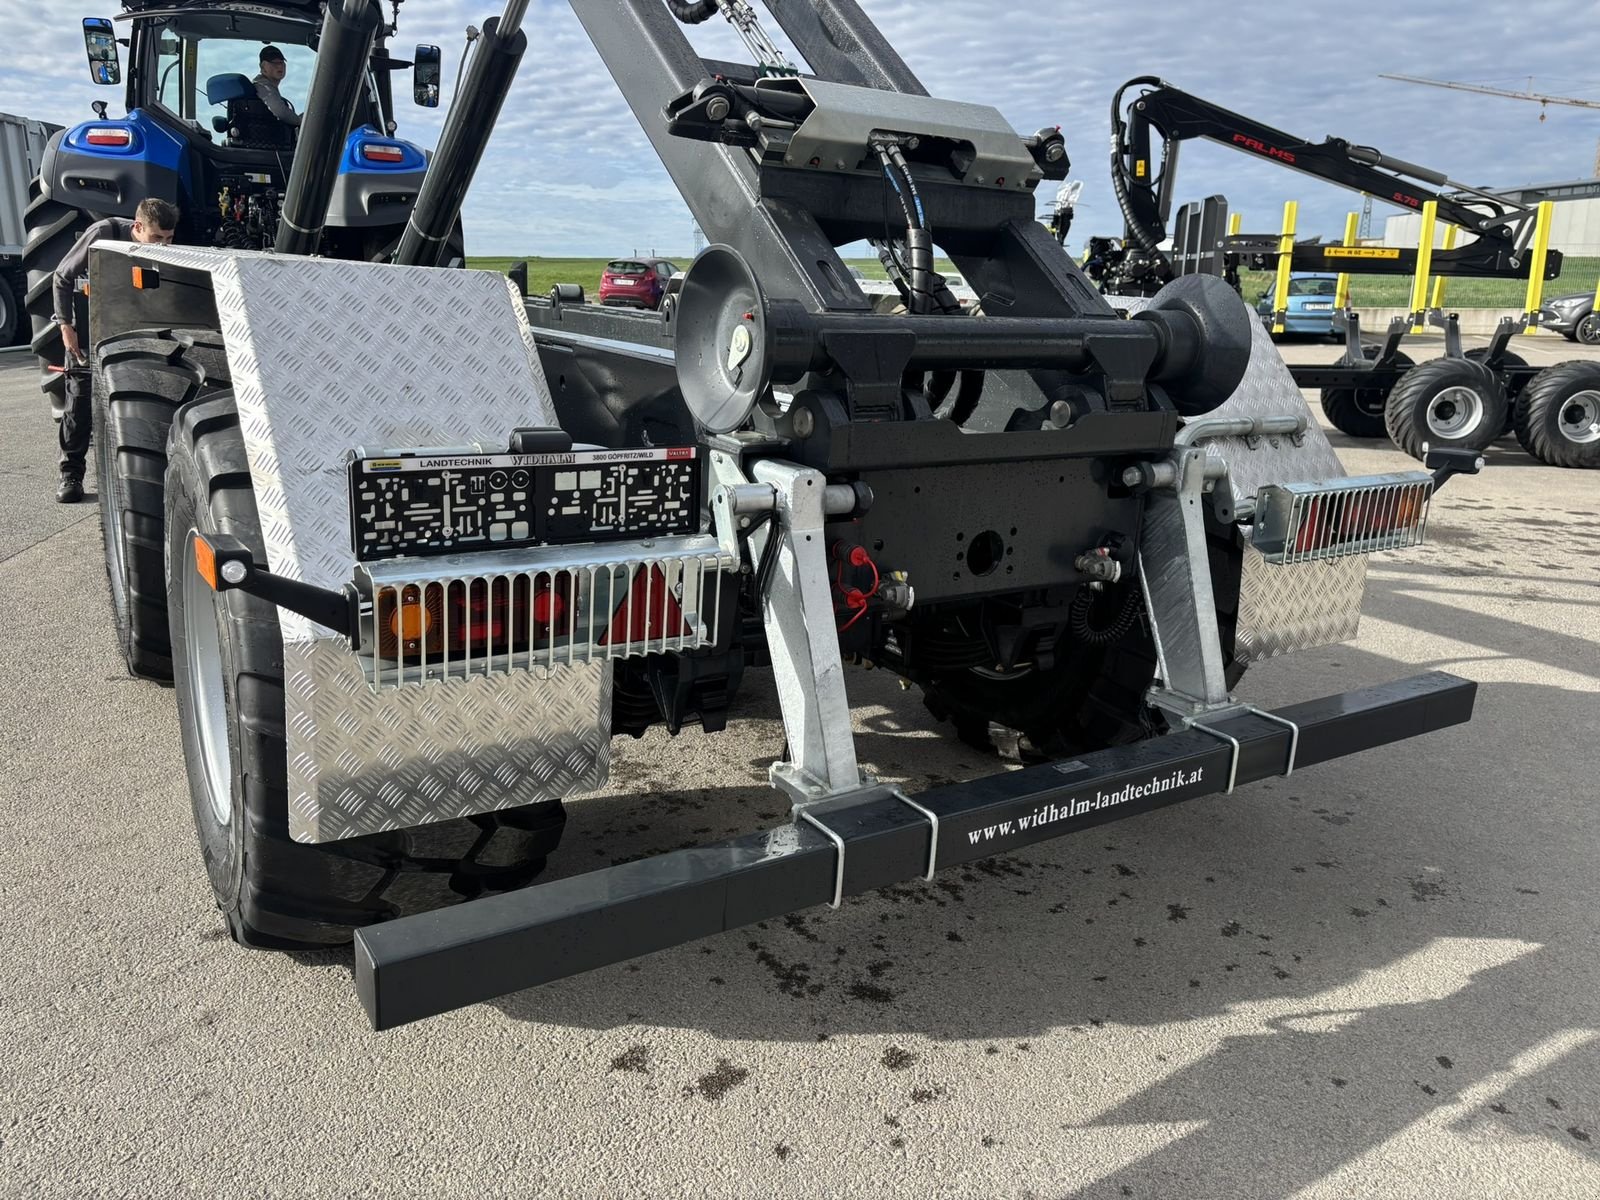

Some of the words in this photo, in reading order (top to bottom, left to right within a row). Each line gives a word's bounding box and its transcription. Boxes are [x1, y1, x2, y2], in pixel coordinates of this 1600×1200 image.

[1232, 133, 1296, 162] PALMS
[419, 457, 492, 468] LANDTECHNIK
[510, 453, 576, 465] WIDHALM
[608, 451, 654, 460] GÖPFRITZ/WILD
[967, 766, 1204, 845] www.widhalm-landtechnik.at
